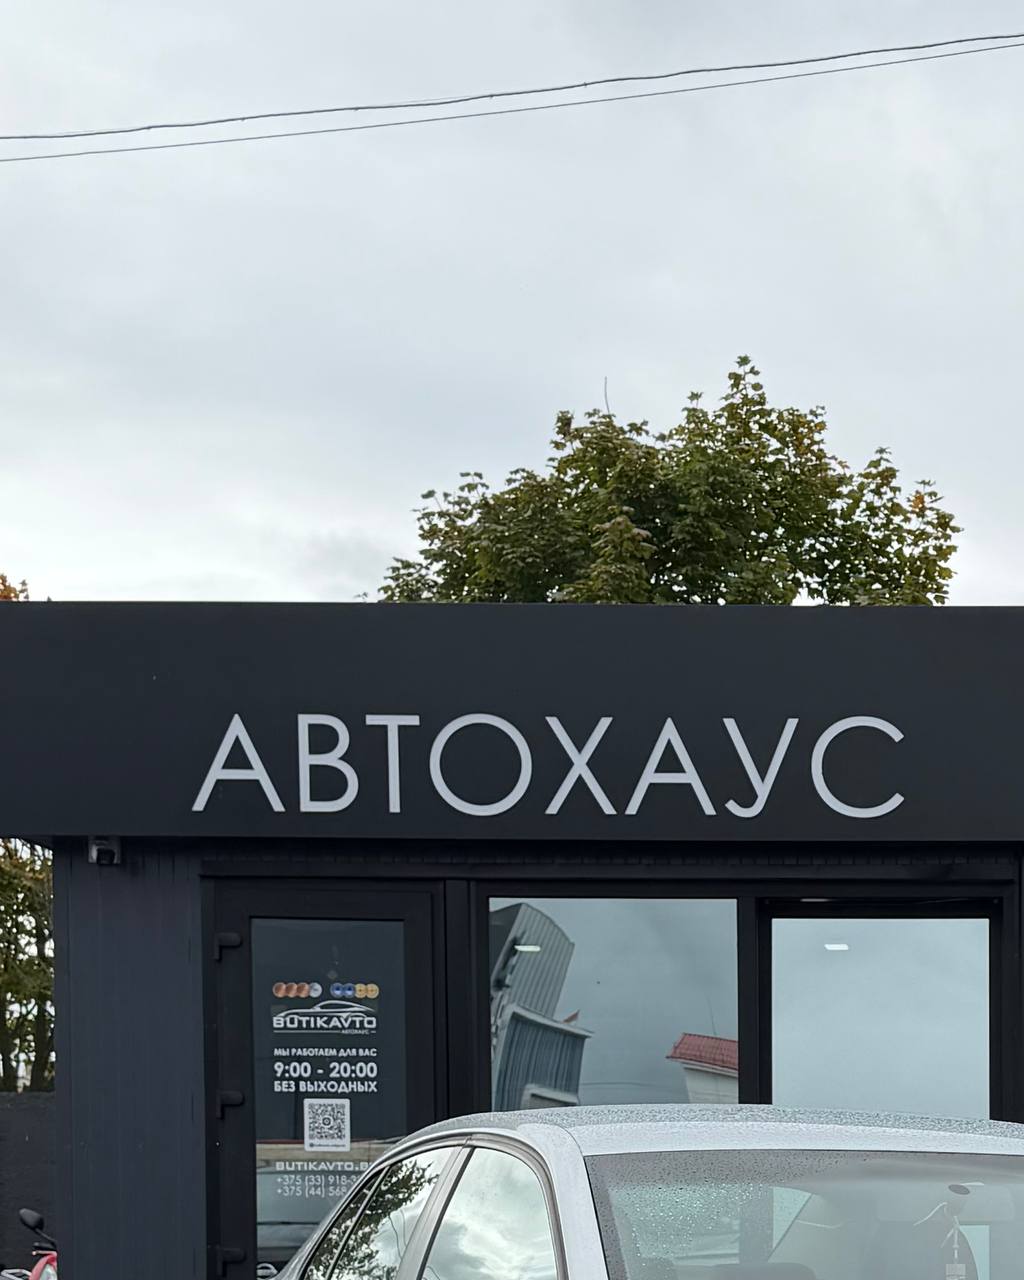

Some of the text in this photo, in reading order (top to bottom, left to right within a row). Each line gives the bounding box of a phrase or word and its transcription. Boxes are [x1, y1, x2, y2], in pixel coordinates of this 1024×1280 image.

[191, 712, 905, 818] АВТОХАУС
[273, 1016, 377, 1028] BUTIKAVTO
[273, 1047, 378, 1058] МЫ РАБОТАЕМ ДЛЯ ВАС
[273, 1061, 312, 1078] 9:00
[329, 1061, 378, 1078] 20:00
[273, 1080, 378, 1094] БЕЗ ВЫХОДНЫХ
[275, 1161, 373, 1171] BUTIKAVTO.B
[276, 1174, 302, 1186] +375
[276, 1186, 302, 1197] +375
[305, 1186, 325, 1198] (44)
